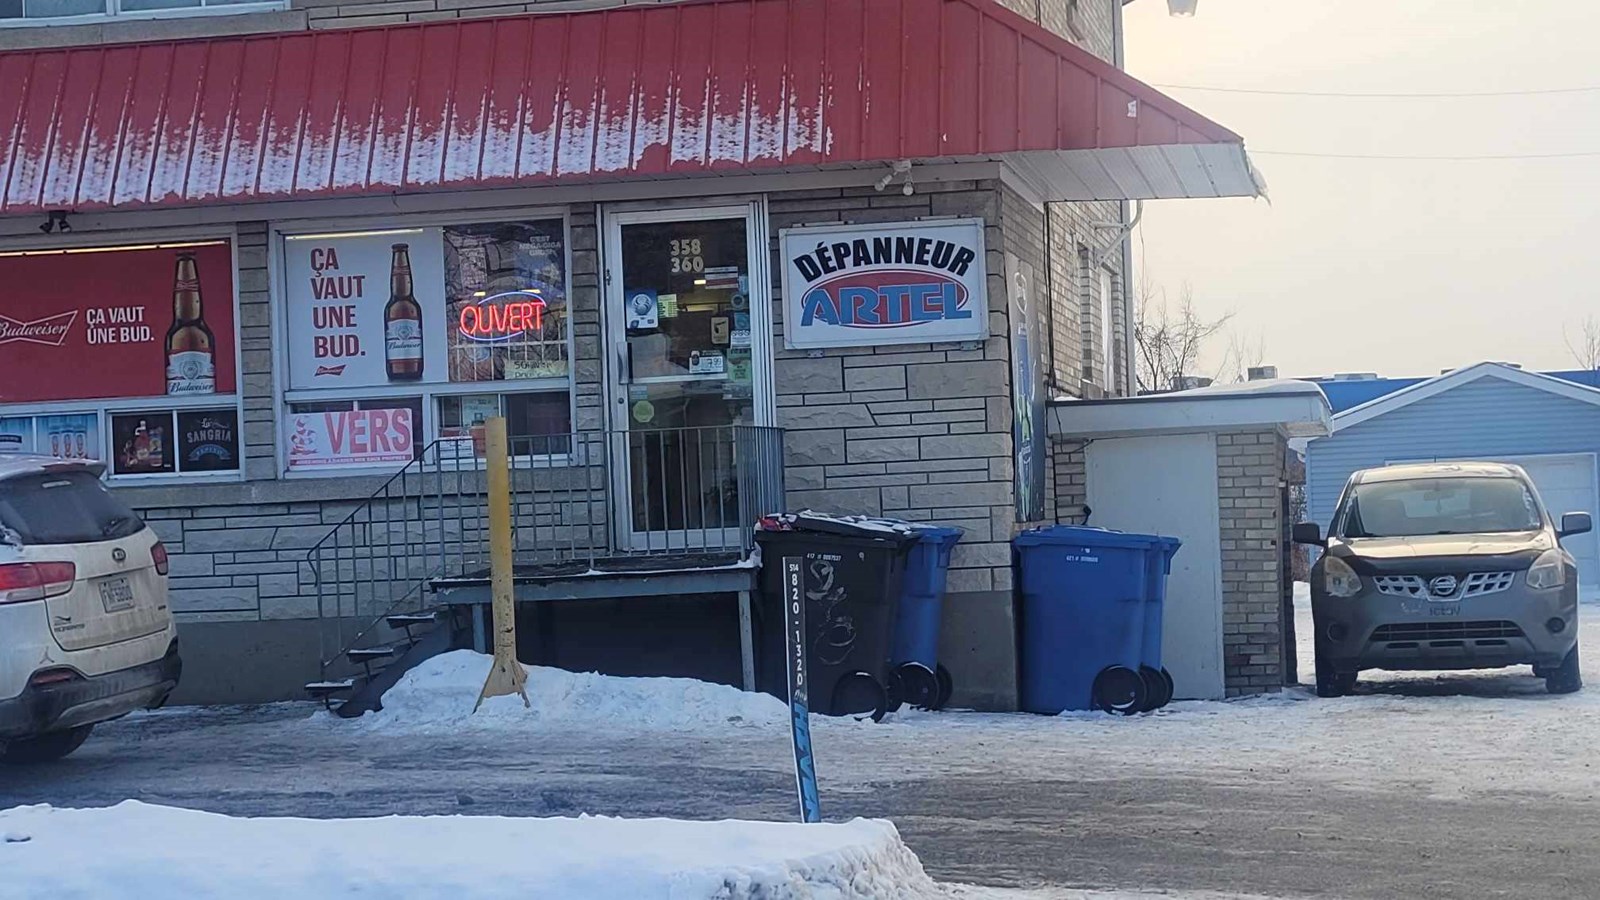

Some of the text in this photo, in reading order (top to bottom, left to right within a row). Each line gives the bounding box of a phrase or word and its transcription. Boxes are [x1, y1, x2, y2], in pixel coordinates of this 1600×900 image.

[670, 239, 701, 255] 358
[793, 236, 976, 282] DÉPANNEUR
[310, 247, 339, 277] ÇA
[670, 256, 704, 273] 360
[310, 275, 366, 300] VAUT
[800, 282, 973, 327] ARTEL
[86, 306, 145, 328] ÇA VAUT
[312, 305, 357, 329] UNE
[459, 302, 544, 334] OUVERT
[87, 326, 155, 344] UNE BUD.
[314, 334, 366, 358] BUD.
[186, 429, 231, 443] SANGRIA
[324, 409, 412, 454] VERS
[789, 563, 799, 572] 514
